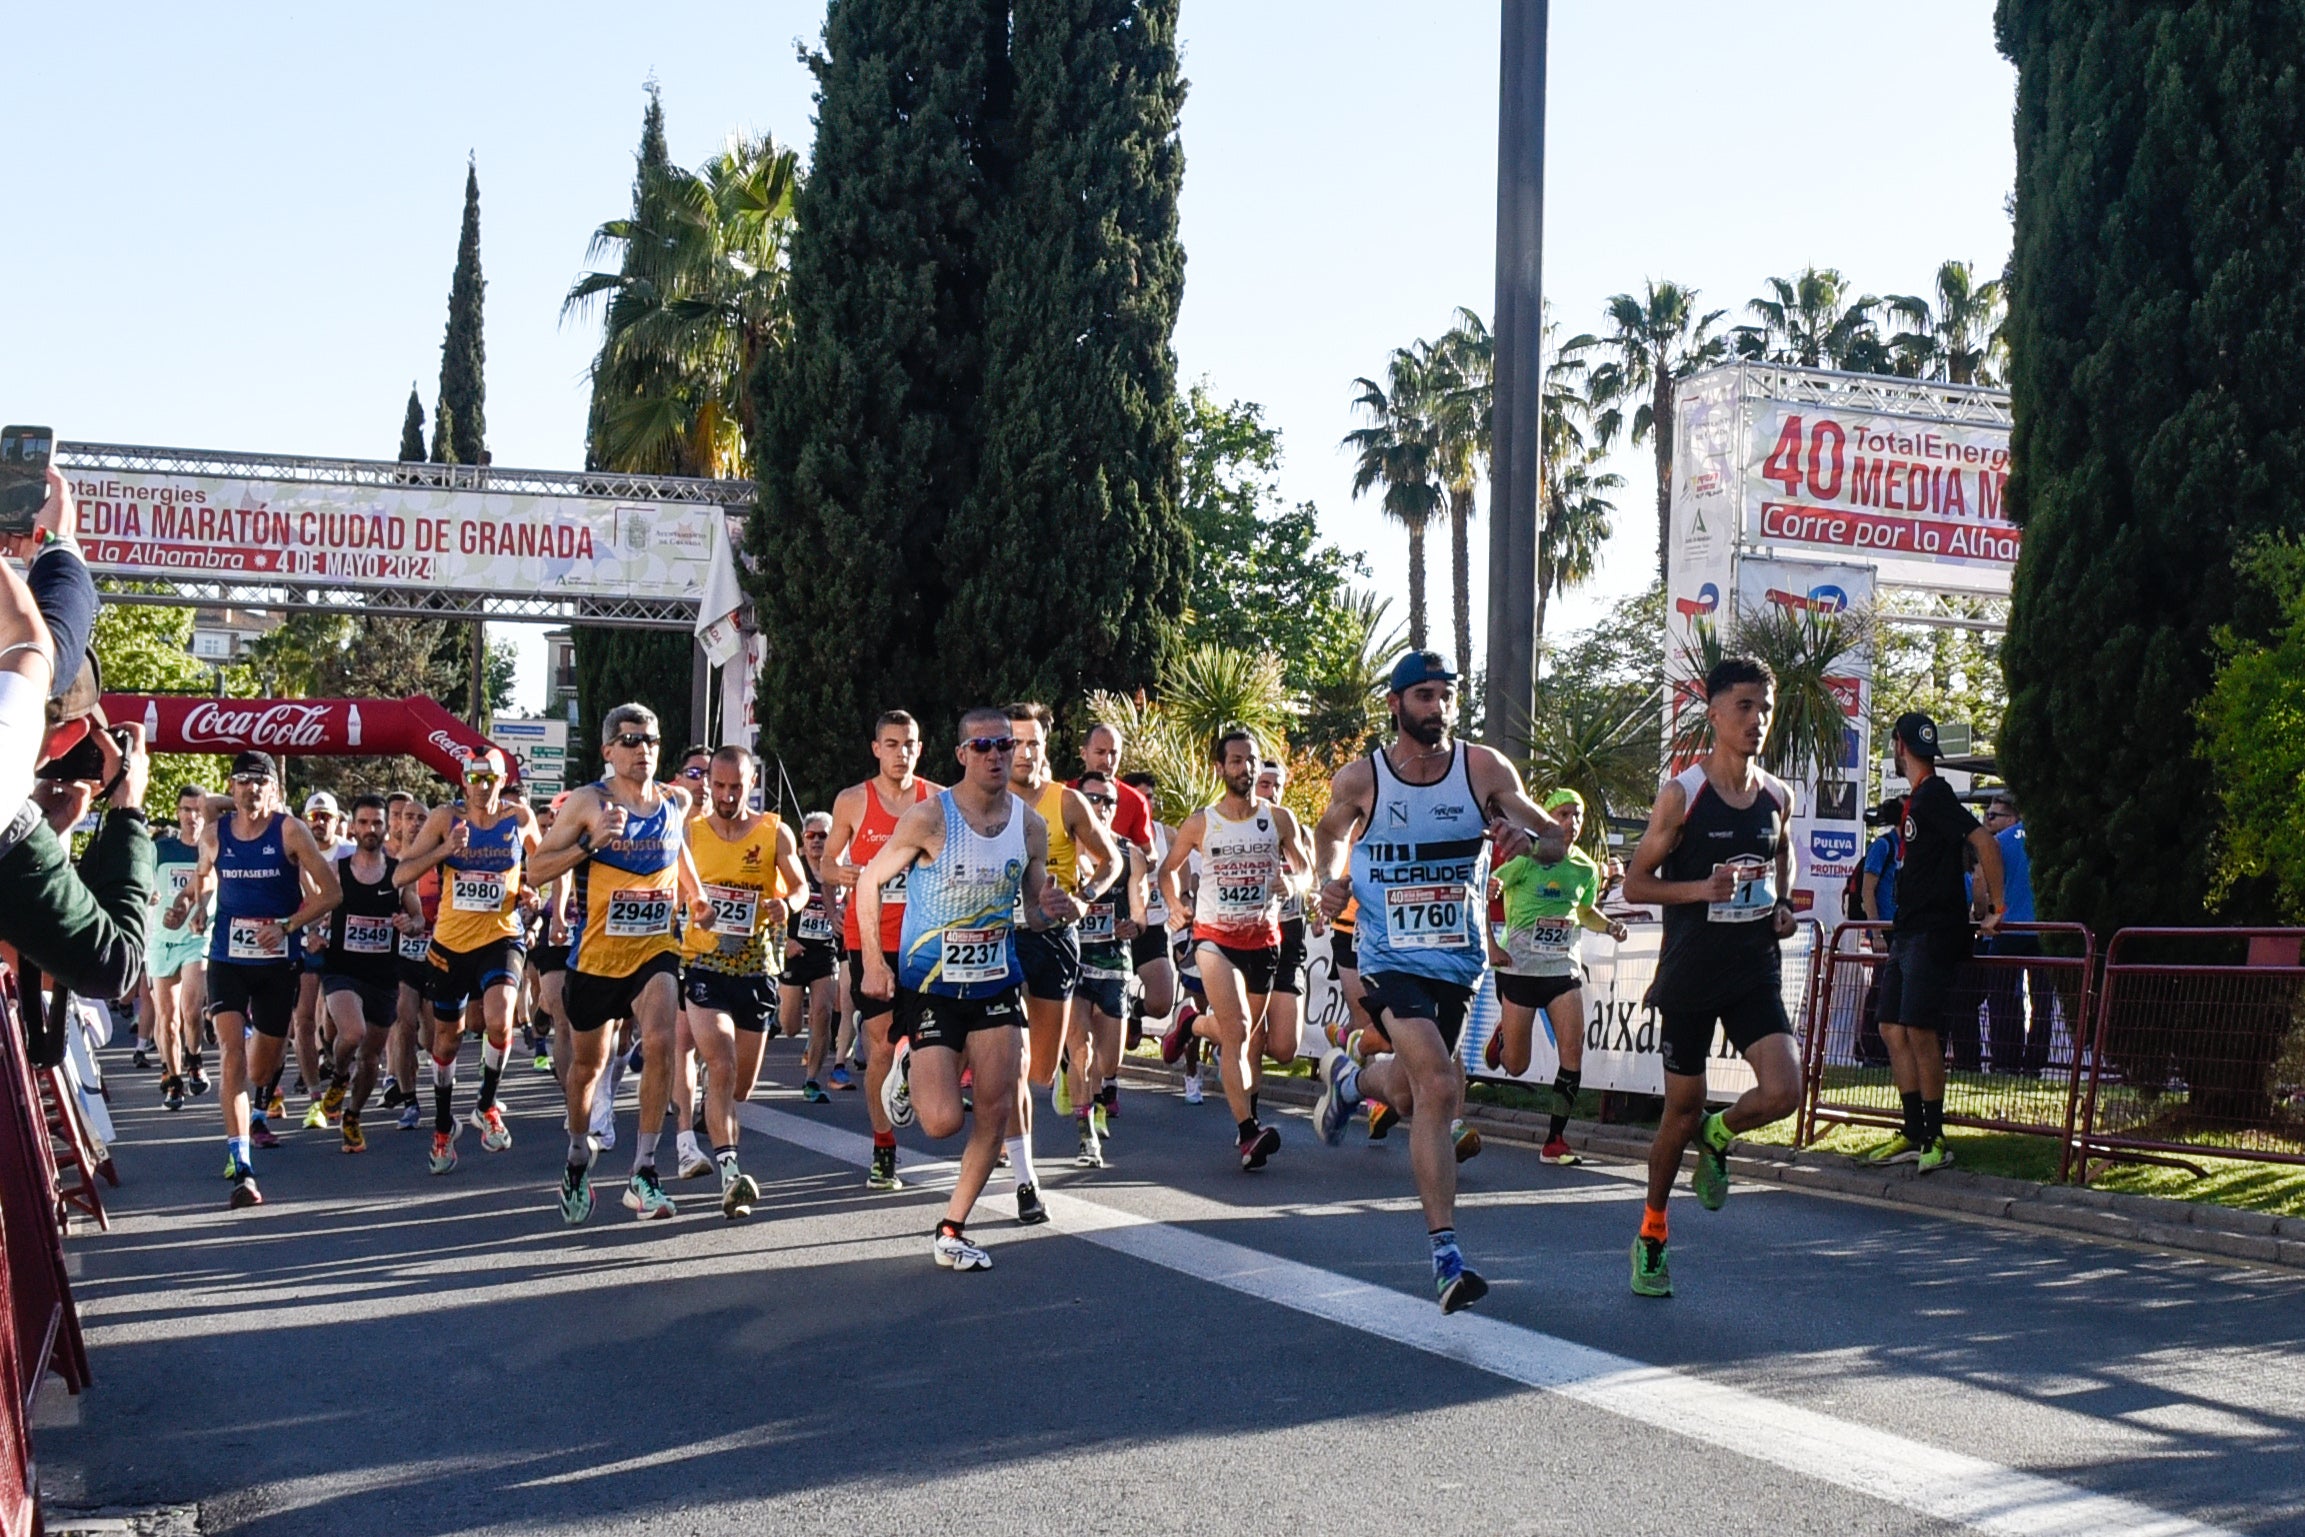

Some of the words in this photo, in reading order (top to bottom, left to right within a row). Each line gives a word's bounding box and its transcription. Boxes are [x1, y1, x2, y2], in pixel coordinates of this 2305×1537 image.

[1762, 415, 1847, 501] 40
[68, 480, 207, 505] otalEnergies
[1850, 456, 1966, 517] MEDIA
[75, 499, 142, 537] EDIA
[151, 502, 291, 546] MARATÓN
[299, 511, 406, 551] CIUDAD
[415, 518, 452, 554] DE
[459, 520, 594, 560] GRANADA
[1763, 505, 1847, 543] Corre
[1852, 522, 1906, 549] por
[1913, 521, 1940, 552] la
[1948, 526, 2020, 560] Alha
[97, 541, 120, 563] la
[125, 543, 245, 569] Alhambra
[275, 550, 290, 574] 4
[295, 551, 319, 575] DE
[325, 552, 381, 578] MAYO
[384, 554, 436, 581] 2024
[181, 702, 333, 746] Coca-Cola
[428, 730, 472, 764] Coca-Co
[1813, 836, 1853, 850] PULEVA
[172, 876, 188, 888] 10
[222, 868, 281, 879] TROTASIERRA
[456, 882, 500, 899] 2980
[1219, 885, 1260, 902] 3422
[611, 902, 666, 921] 2948
[711, 900, 748, 921] 525
[1392, 903, 1457, 930] 1760
[233, 928, 257, 945] 42
[347, 926, 388, 942] 2549
[1535, 927, 1570, 943] 2524
[402, 939, 429, 953] 257
[946, 942, 999, 965] 2237
